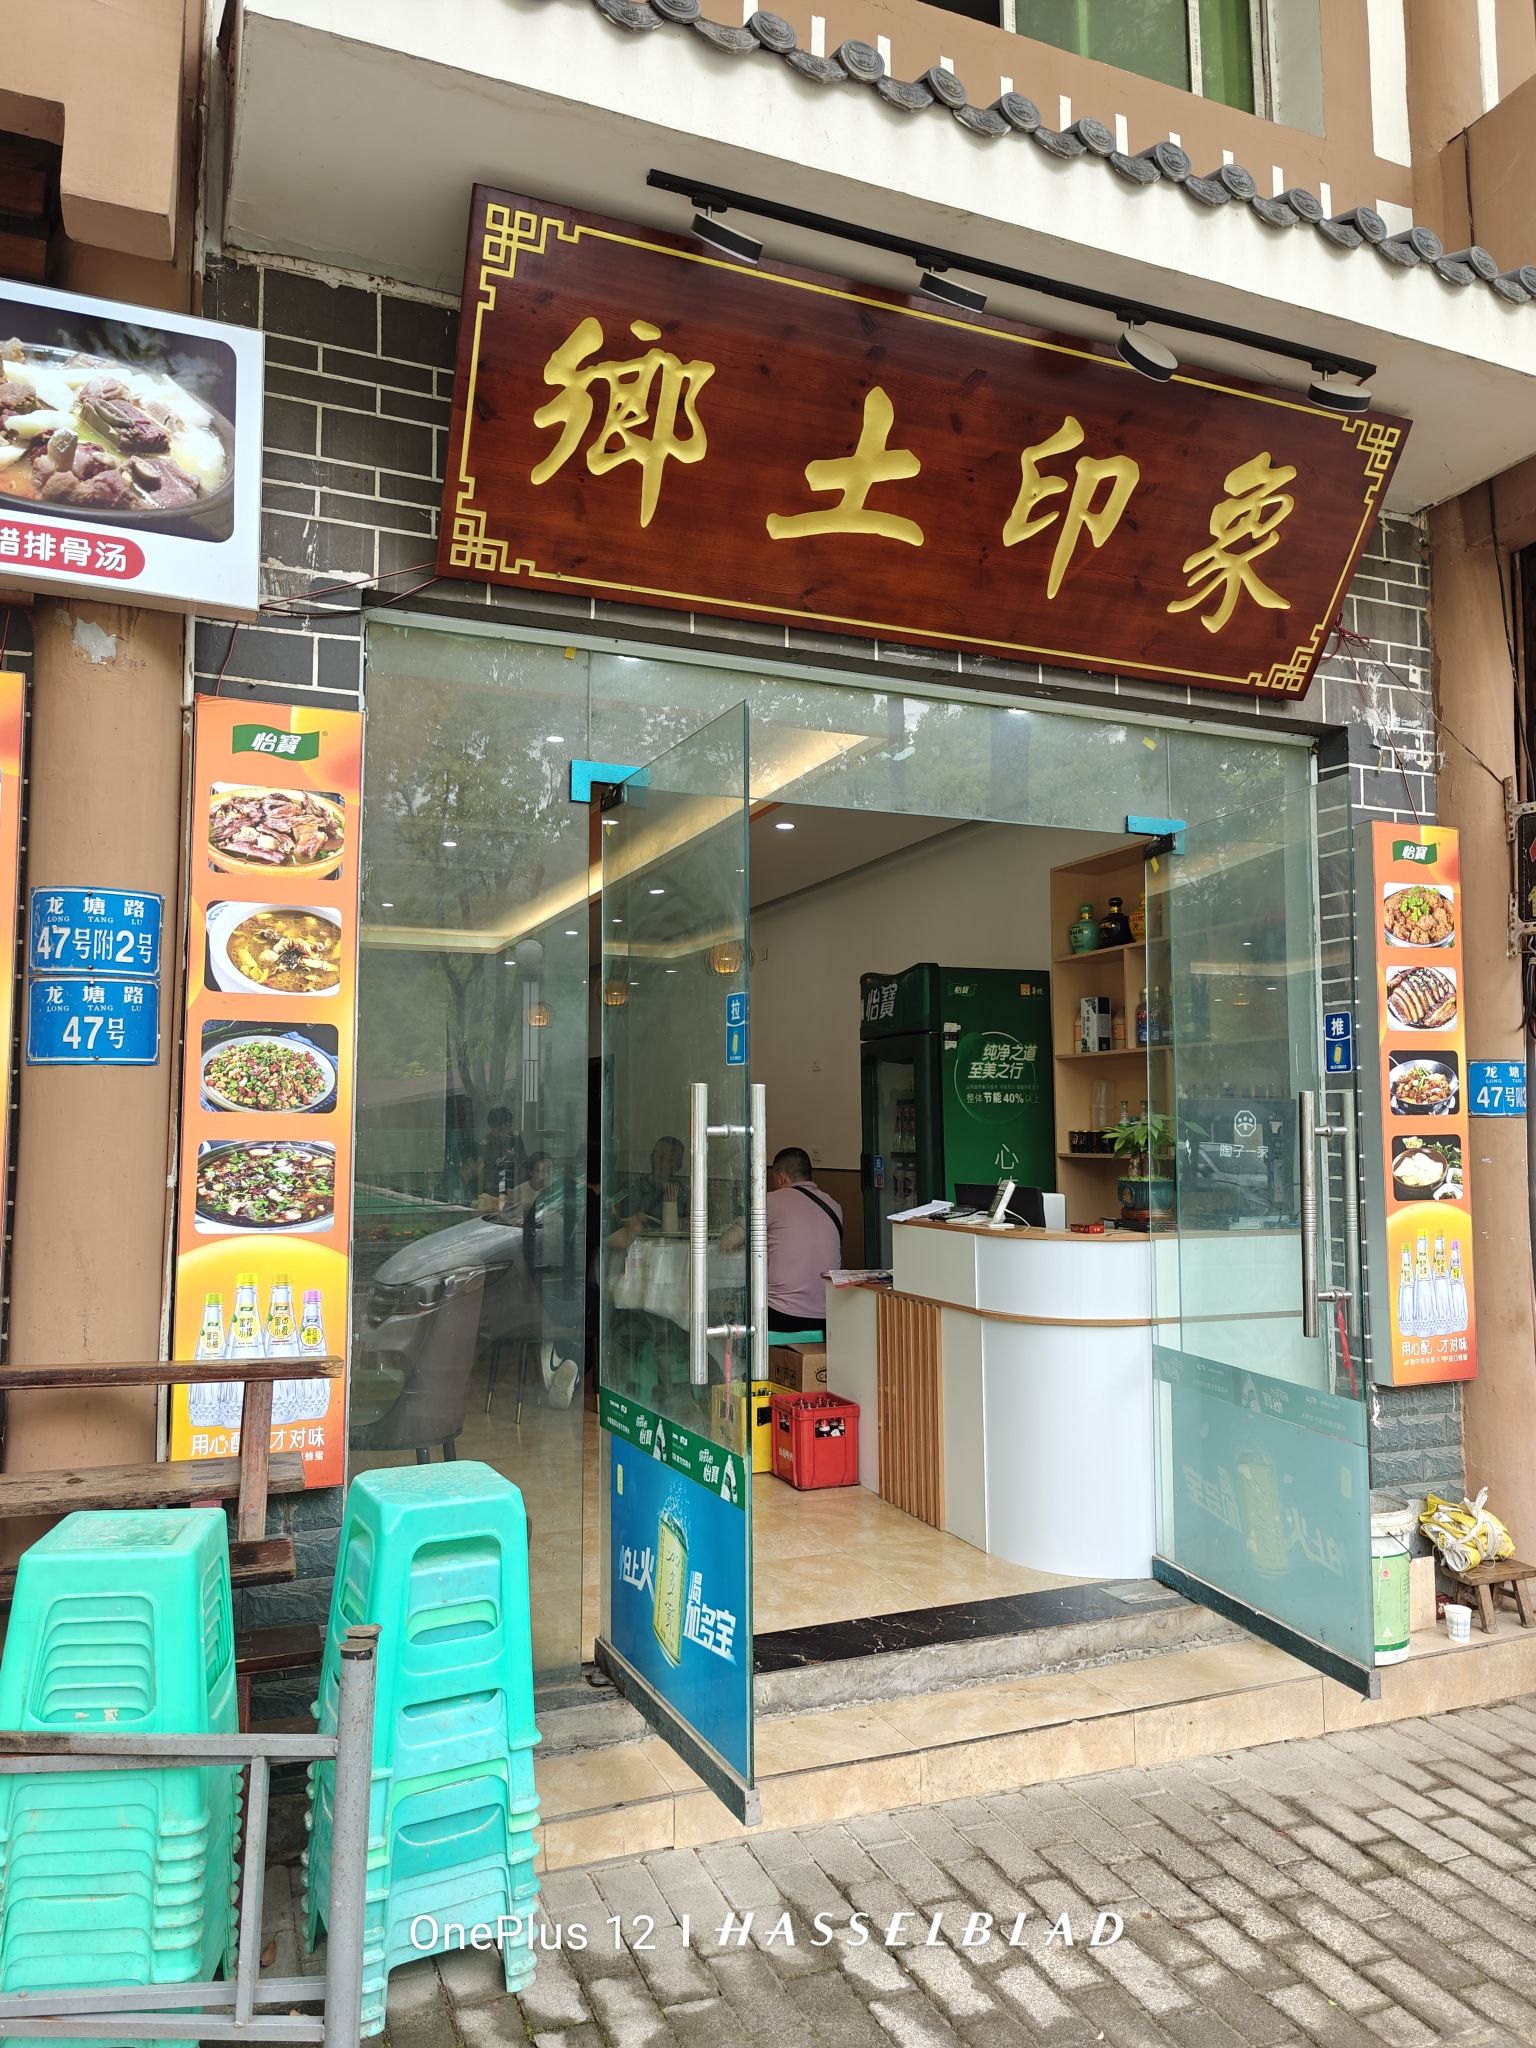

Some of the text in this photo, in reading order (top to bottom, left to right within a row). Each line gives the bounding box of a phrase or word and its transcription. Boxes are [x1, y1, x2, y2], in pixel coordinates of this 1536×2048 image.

[530, 315, 1297, 635] 鄉土印象
[46, 896, 145, 919] 龙塘路
[47, 915, 143, 926] LONG TANG LU
[36, 925, 153, 964] 47号附2号
[45, 985, 144, 1005] 龙塘路
[46, 1005, 70, 1013] LONG
[731, 999, 741, 1021] 拉
[62, 1016, 126, 1050] 47号
[1331, 1017, 1345, 1036] 推
[982, 1043, 1039, 1062] 纯净之道
[967, 1061, 1024, 1080] 至美之行
[1482, 1065, 1527, 1079] 龙塘
[1219, 1144, 1269, 1159] 陶子一家
[1436, 1335, 1468, 1353] 才对味
